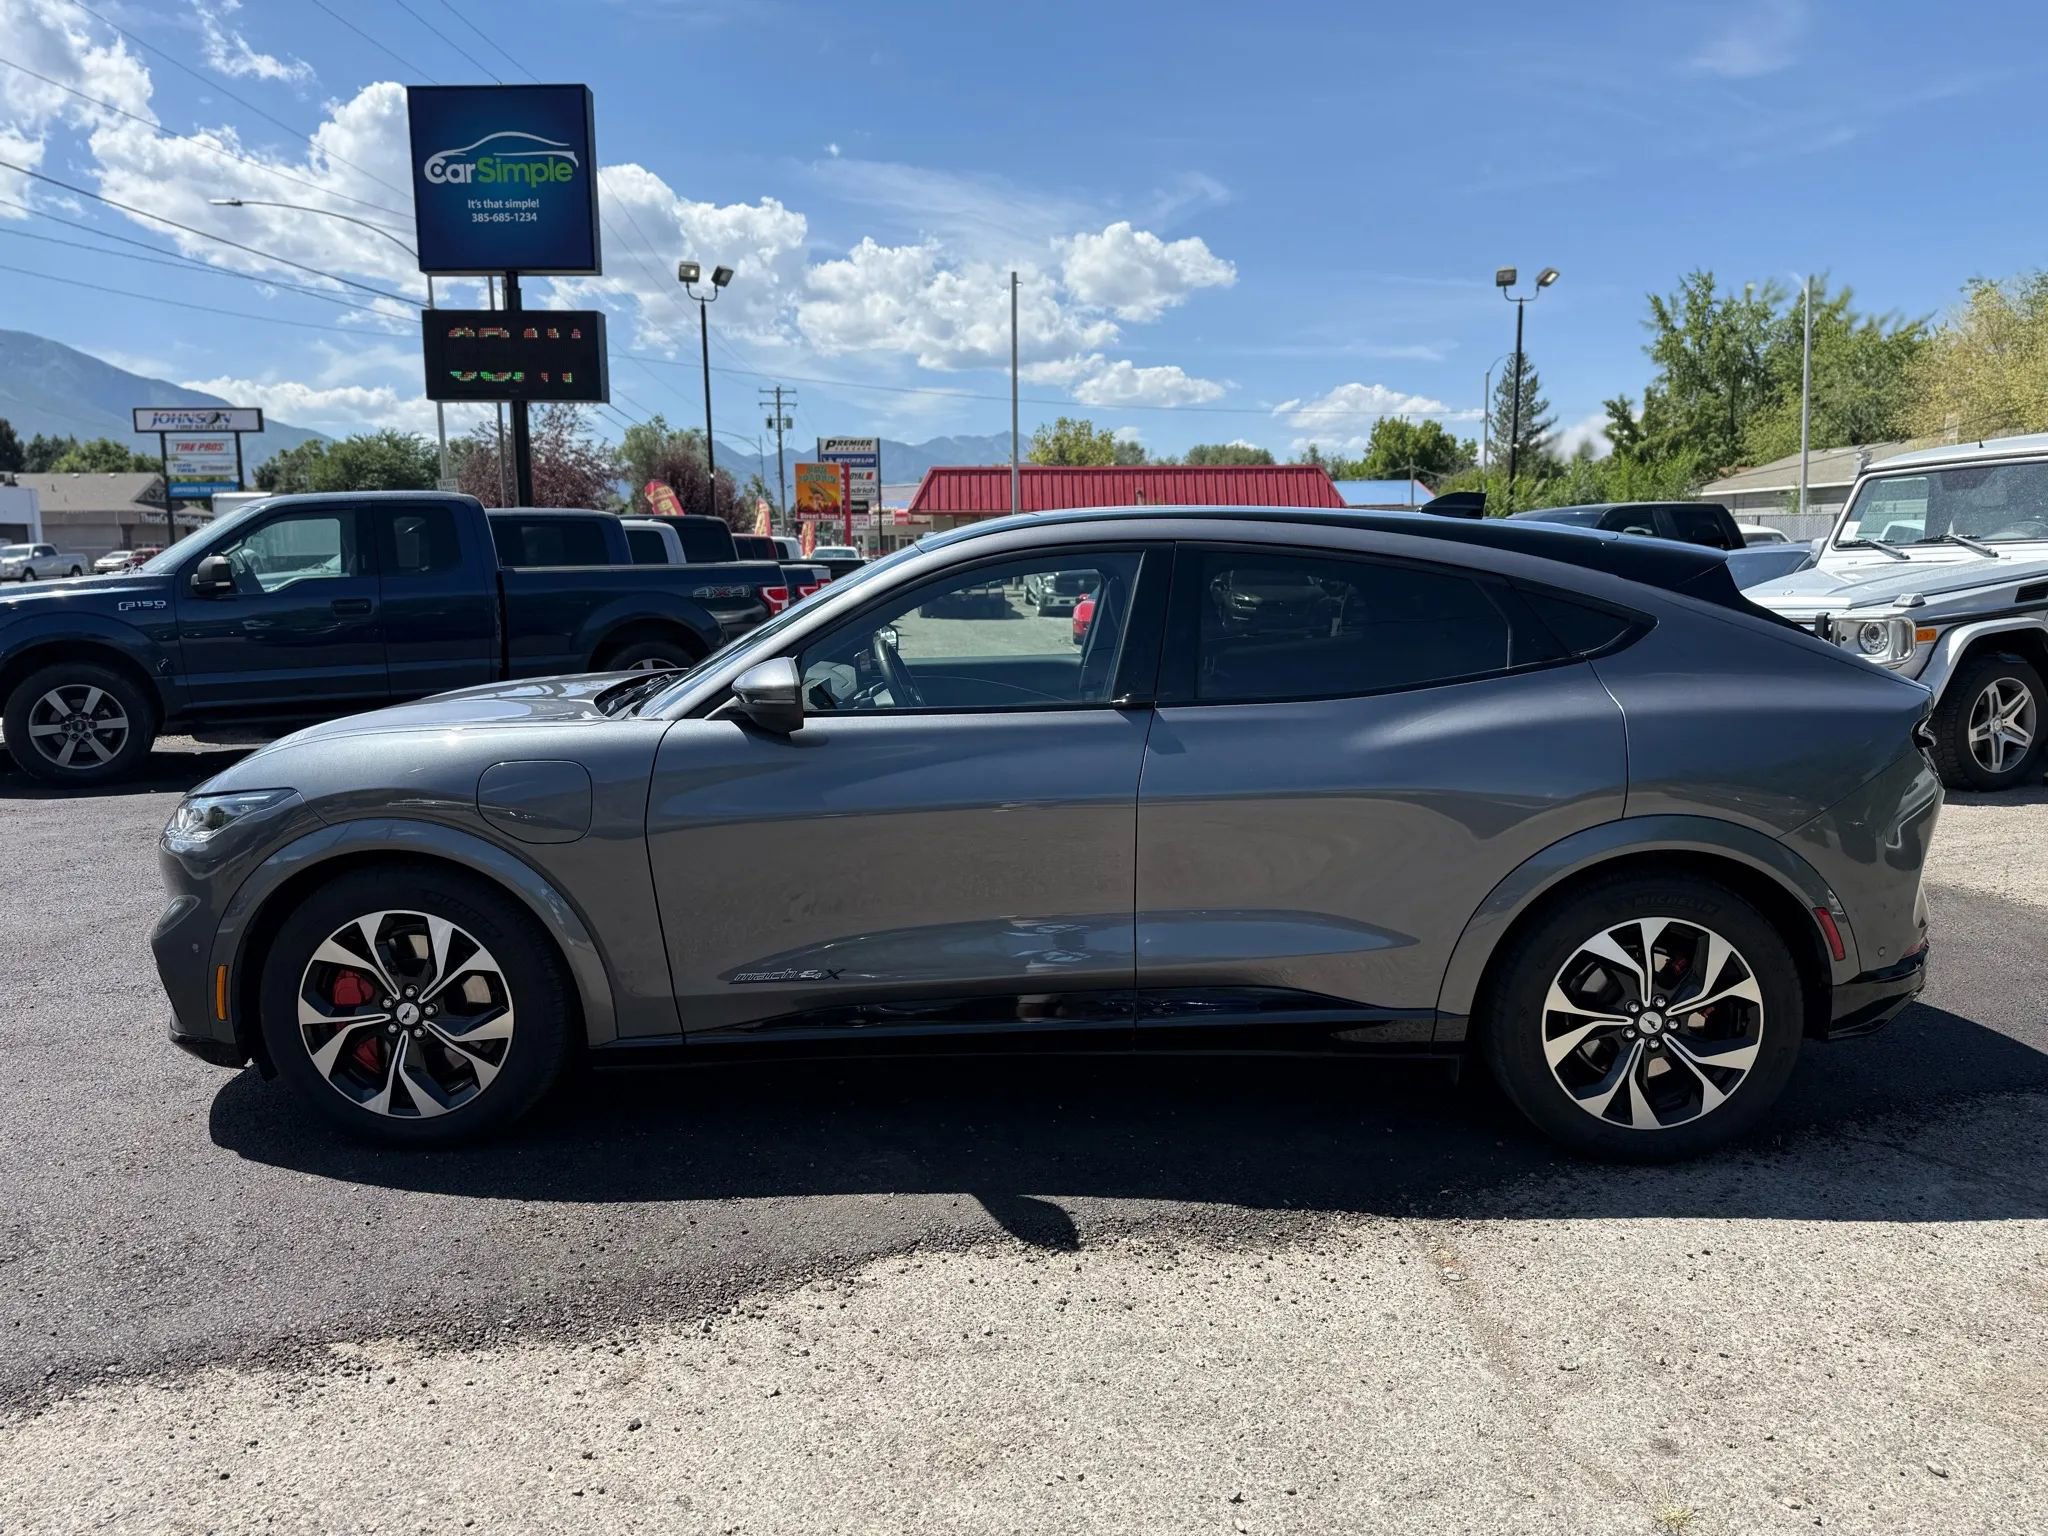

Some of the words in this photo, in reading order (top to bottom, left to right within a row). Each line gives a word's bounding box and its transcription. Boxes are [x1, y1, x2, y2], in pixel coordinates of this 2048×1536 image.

[424, 155, 573, 188] CarSimple
[467, 199, 483, 209] It's
[483, 199, 503, 209] that
[505, 199, 540, 211] simple!
[471, 212, 538, 223] 385-685-1234
[175, 442, 197, 452] TIRE
[198, 442, 225, 452] PROS
[825, 439, 873, 450] PREMIER
[835, 457, 875, 465] MICHELIN
[800, 512, 820, 520] Street
[821, 512, 839, 520] Tacos
